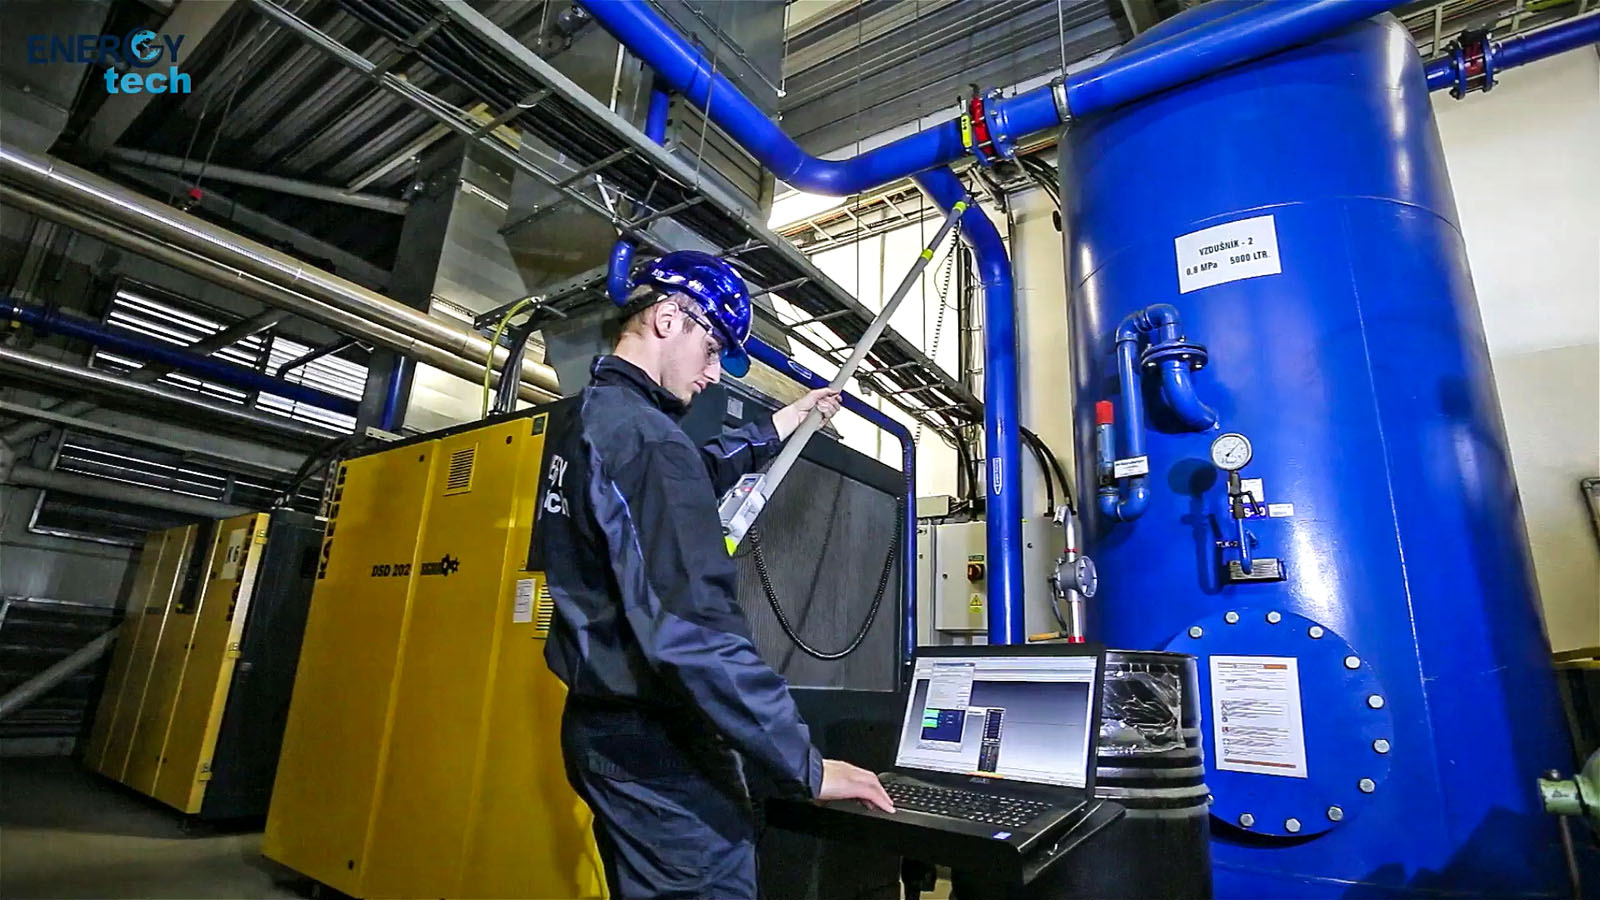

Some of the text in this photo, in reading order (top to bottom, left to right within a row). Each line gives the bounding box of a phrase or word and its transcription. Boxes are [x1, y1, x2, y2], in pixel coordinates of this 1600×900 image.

[1199, 239, 1239, 256] VZDUŠNÍK
[1247, 237, 1253, 246] 2
[1201, 261, 1218, 272] MPa
[1229, 253, 1251, 264] 5000
[371, 564, 391, 577] DSD
[392, 563, 412, 577] 202
